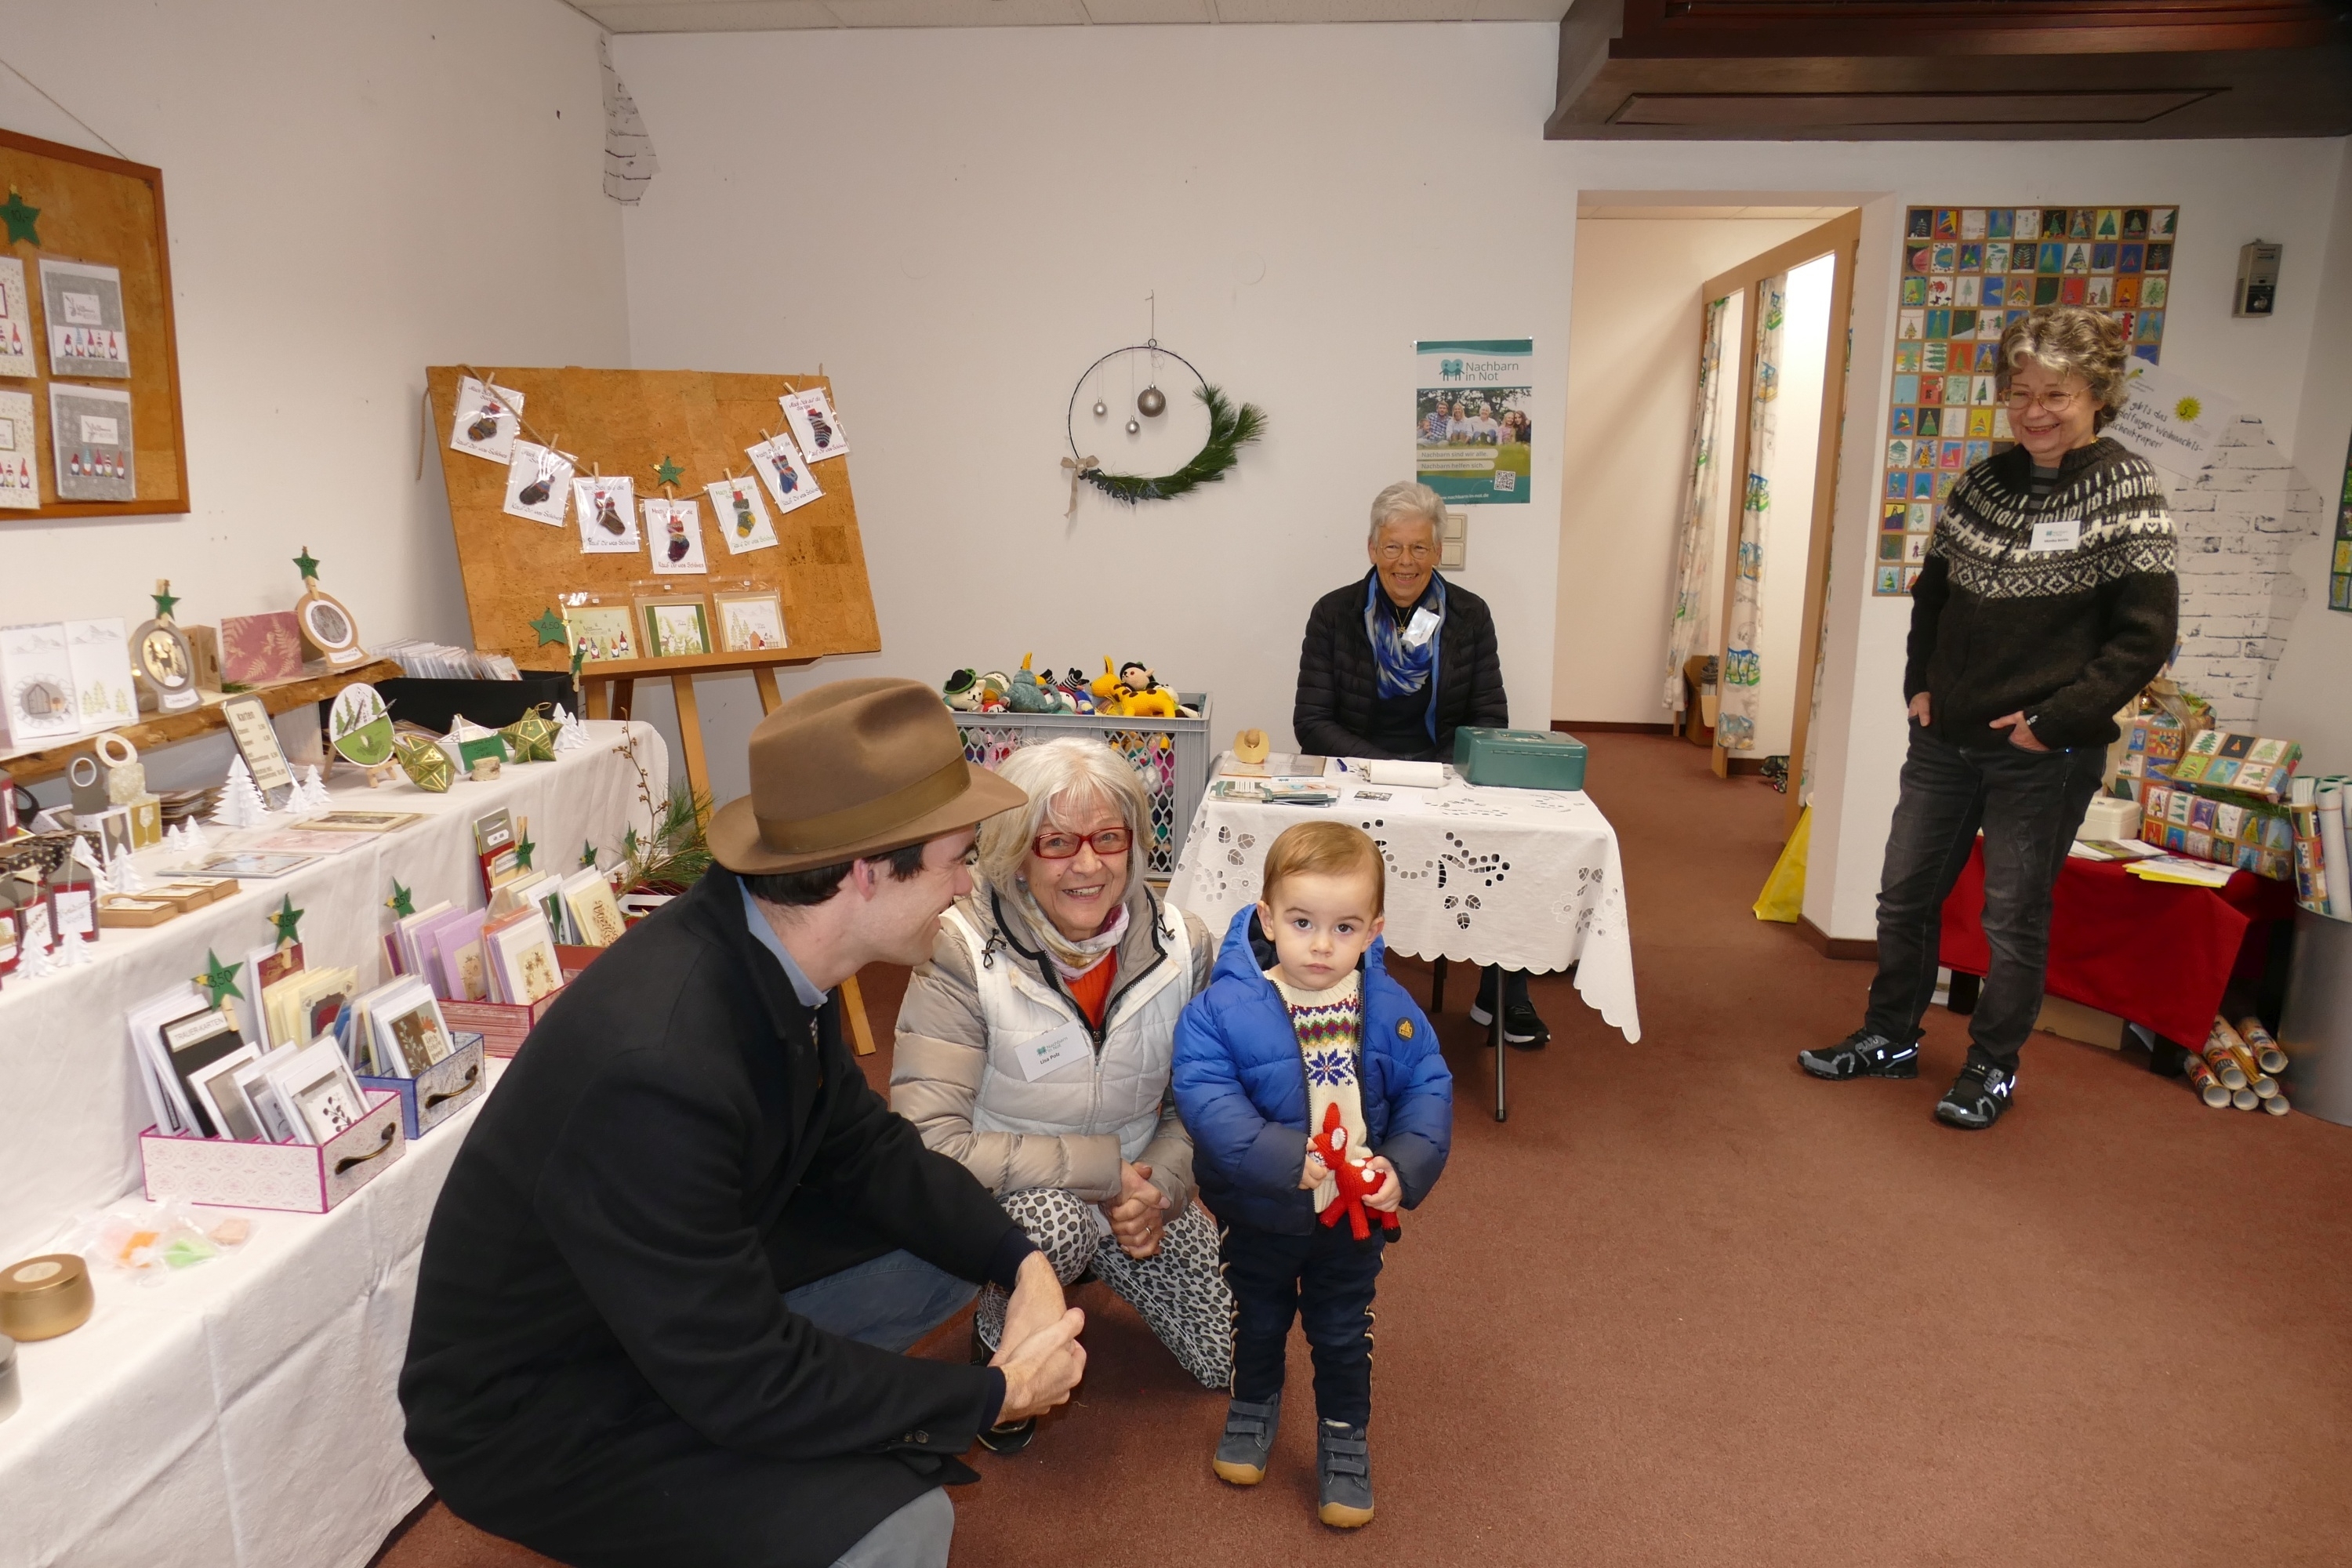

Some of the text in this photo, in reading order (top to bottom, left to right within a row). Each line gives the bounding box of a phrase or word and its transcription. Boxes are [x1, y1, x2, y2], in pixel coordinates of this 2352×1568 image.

[1465, 361, 1519, 372] Nachbarn
[1465, 372, 1498, 382] in Not
[2154, 410, 2168, 422] das
[237, 711, 256, 721] Karten
[208, 970, 233, 989] 3,50
[174, 1018, 224, 1040] TRAUER-KARTEN
[1046, 1036, 1068, 1048] Nachbarn
